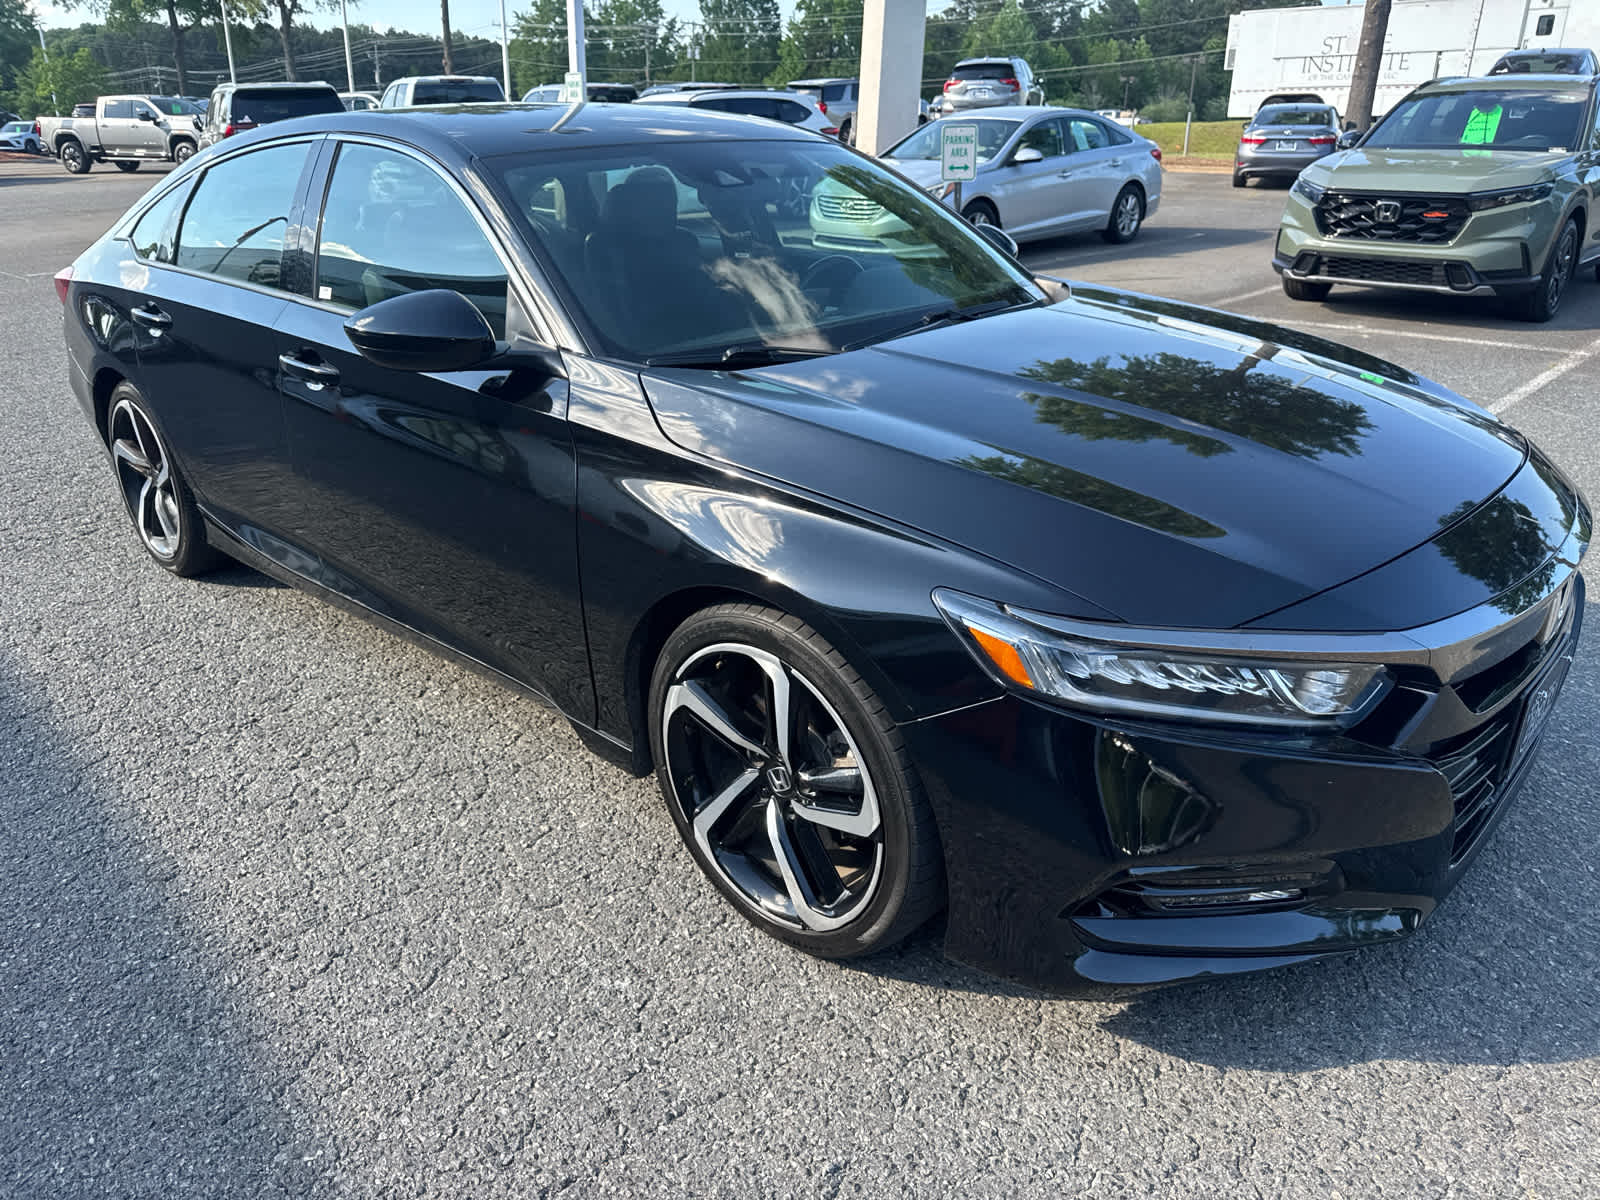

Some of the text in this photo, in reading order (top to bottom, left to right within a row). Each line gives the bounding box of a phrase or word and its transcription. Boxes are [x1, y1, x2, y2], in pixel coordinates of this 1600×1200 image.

[1301, 53, 1409, 73] INSTITE
[945, 135, 975, 145] PARKING
[951, 147, 968, 156] AREA
